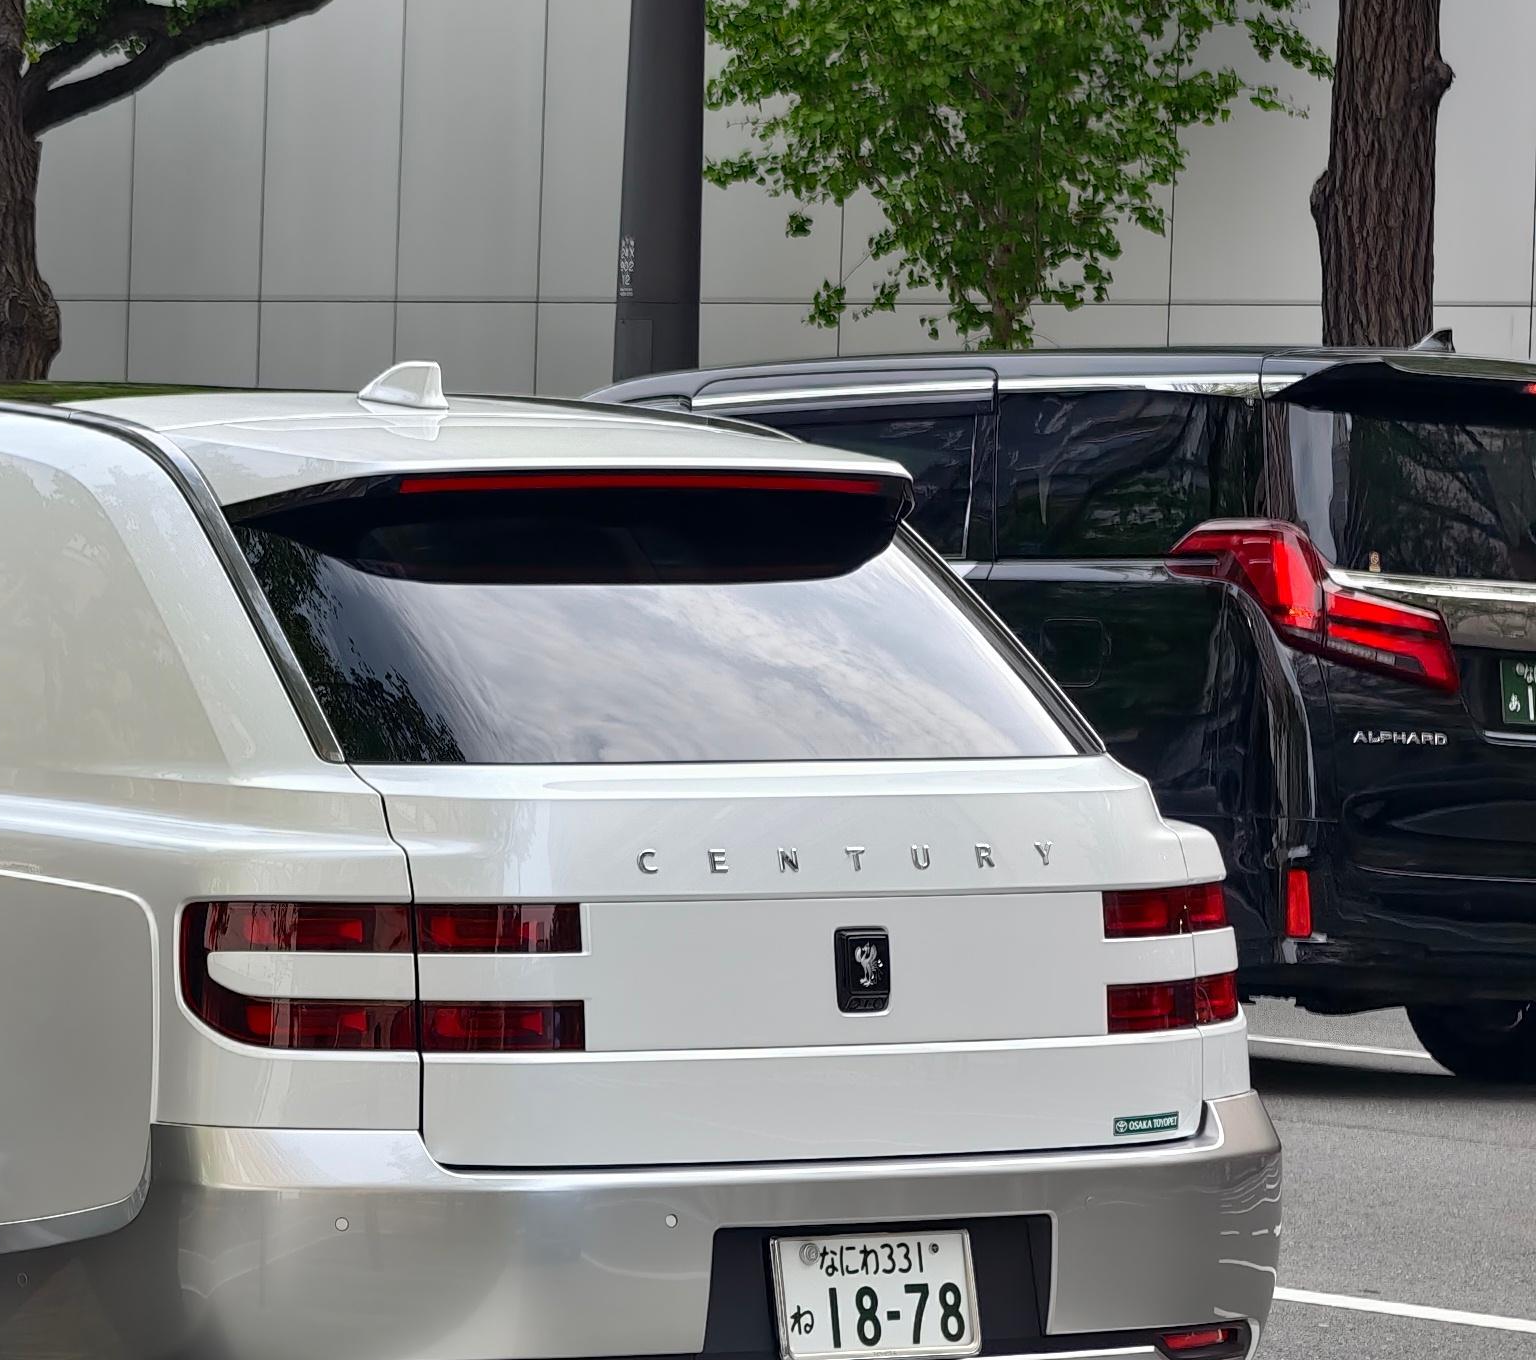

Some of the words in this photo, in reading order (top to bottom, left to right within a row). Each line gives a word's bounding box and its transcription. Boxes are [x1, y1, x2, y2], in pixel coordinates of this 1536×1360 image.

[1353, 730, 1448, 746] ALPHARD
[637, 841, 1054, 874] CENTURY
[1128, 1120, 1152, 1130] OSAKA
[1153, 1116, 1177, 1128] TOYOPET
[790, 1304, 814, 1335] ね
[828, 1282, 965, 1348] 18-78
